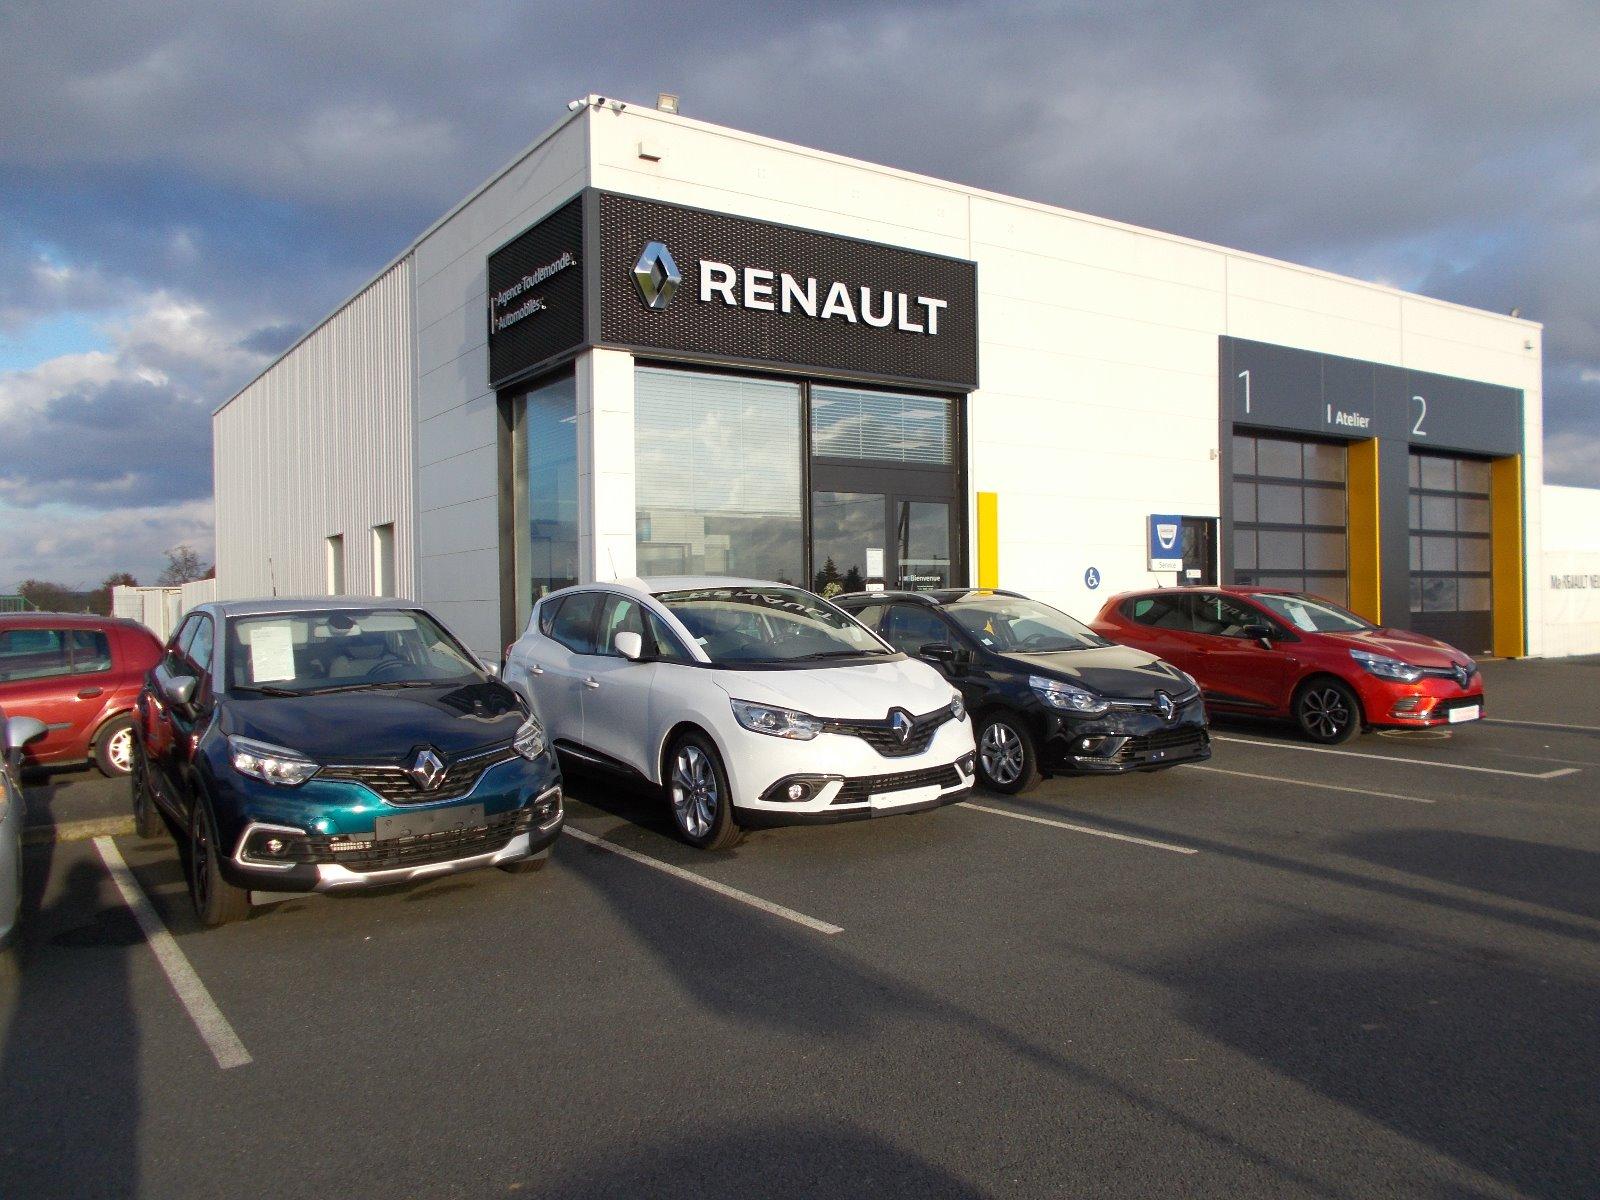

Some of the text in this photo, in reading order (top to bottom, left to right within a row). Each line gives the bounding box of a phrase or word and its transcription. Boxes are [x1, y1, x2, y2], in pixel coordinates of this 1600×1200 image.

[497, 283, 523, 307] Agence
[700, 260, 947, 335] RENAULT
[1238, 369, 1250, 414] 1
[1335, 410, 1370, 428] Atelier
[1412, 395, 1427, 436] 2
[910, 574, 941, 582] Bienvenue
